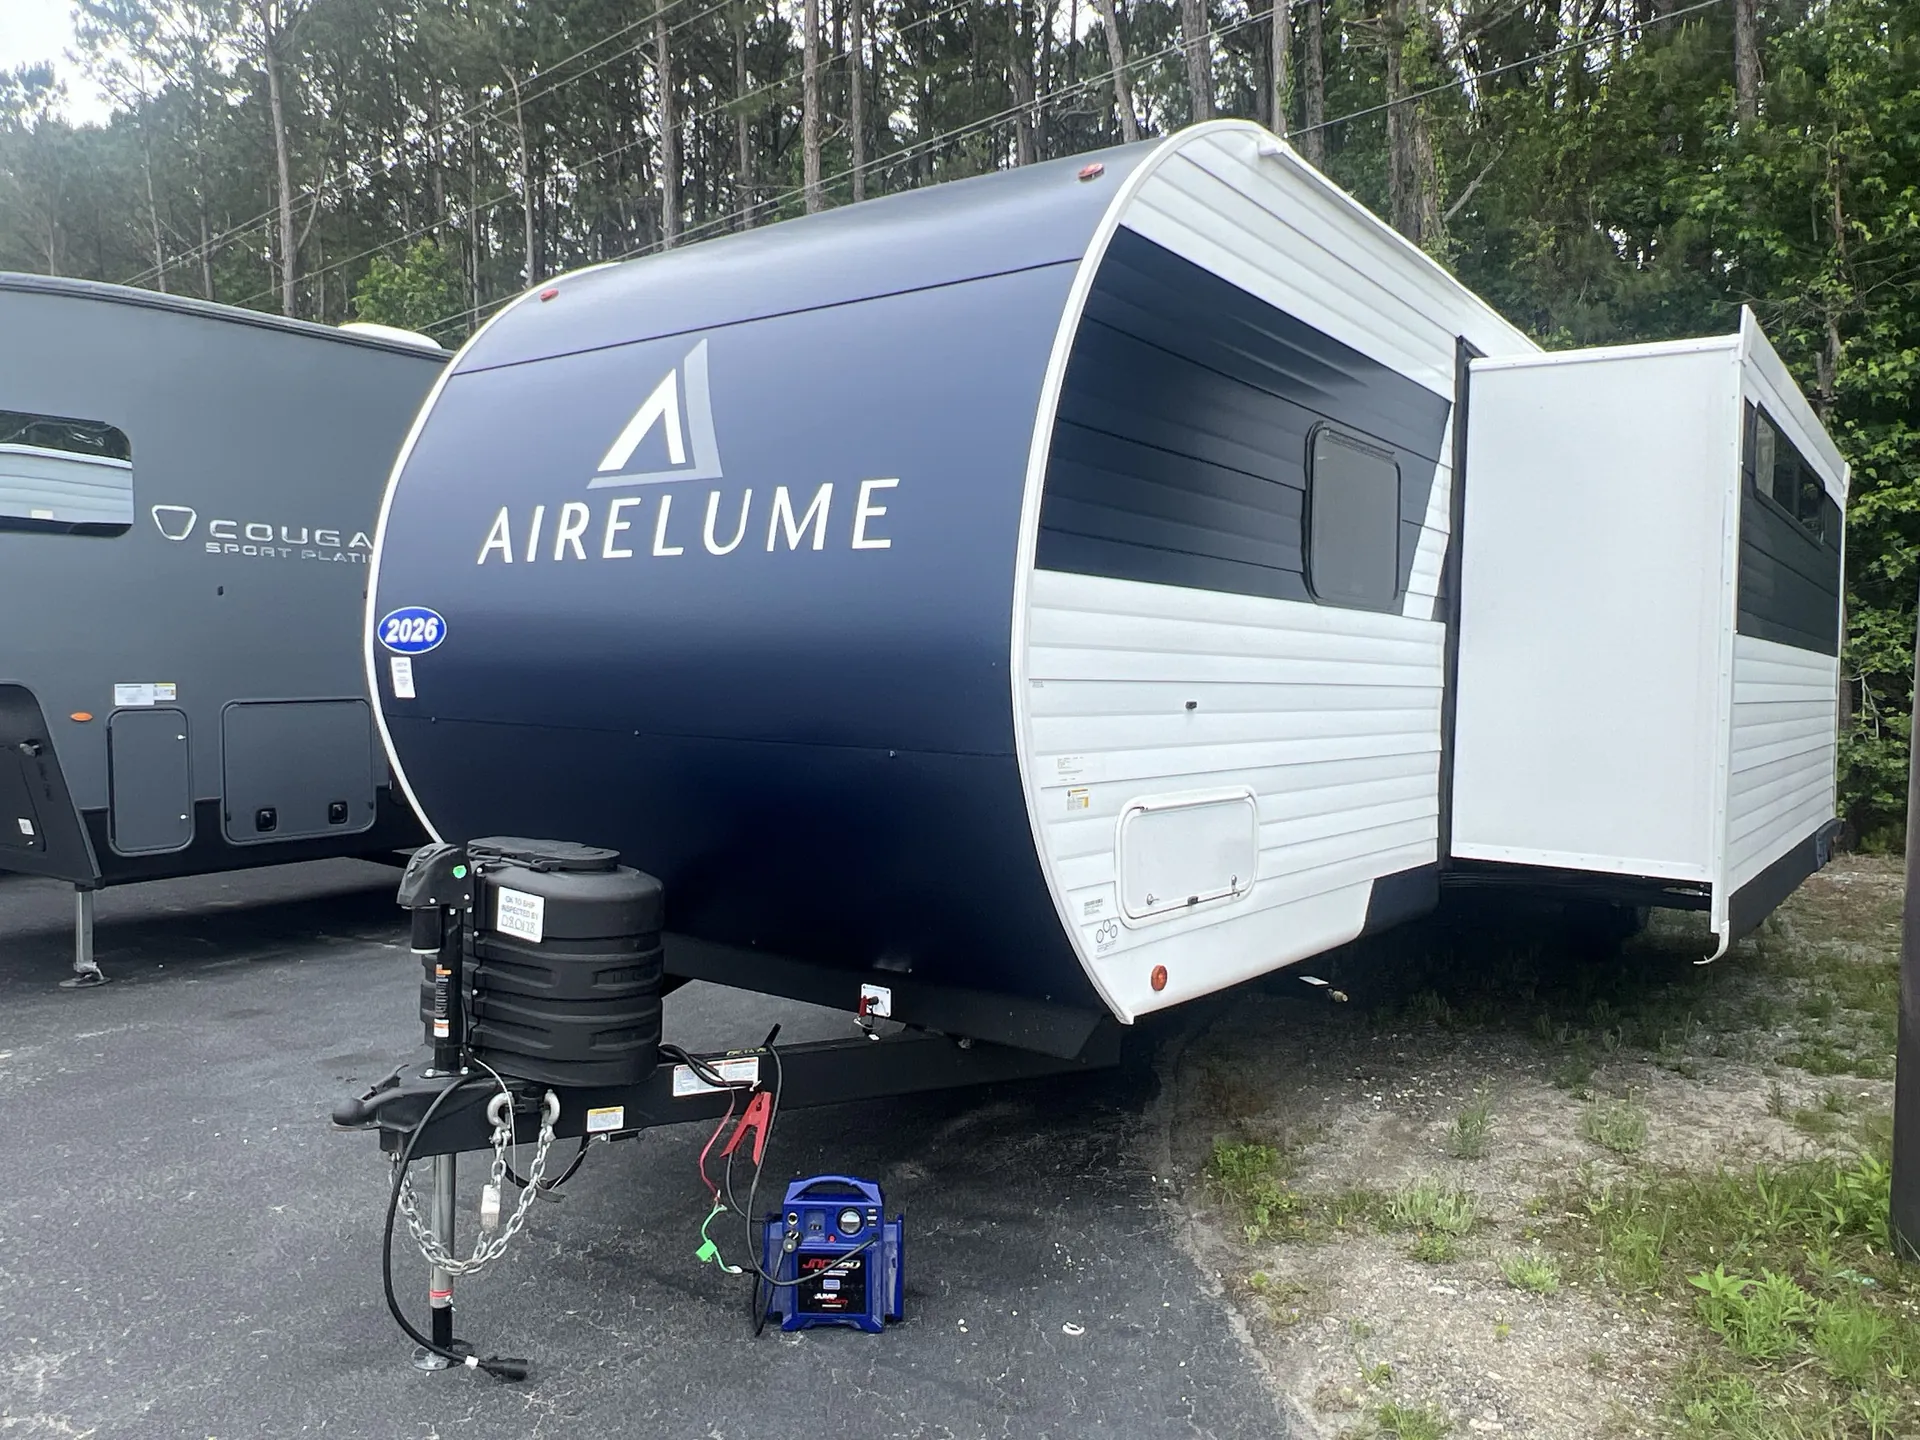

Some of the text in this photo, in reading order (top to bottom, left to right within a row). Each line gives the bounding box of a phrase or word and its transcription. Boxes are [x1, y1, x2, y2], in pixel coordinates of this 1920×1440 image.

[477, 478, 900, 565] AIRELUME
[205, 542, 373, 564] SPORT PLATI
[384, 617, 439, 643] 2026
[501, 904, 531, 918] INSPECTED
[514, 897, 522, 905] TO
